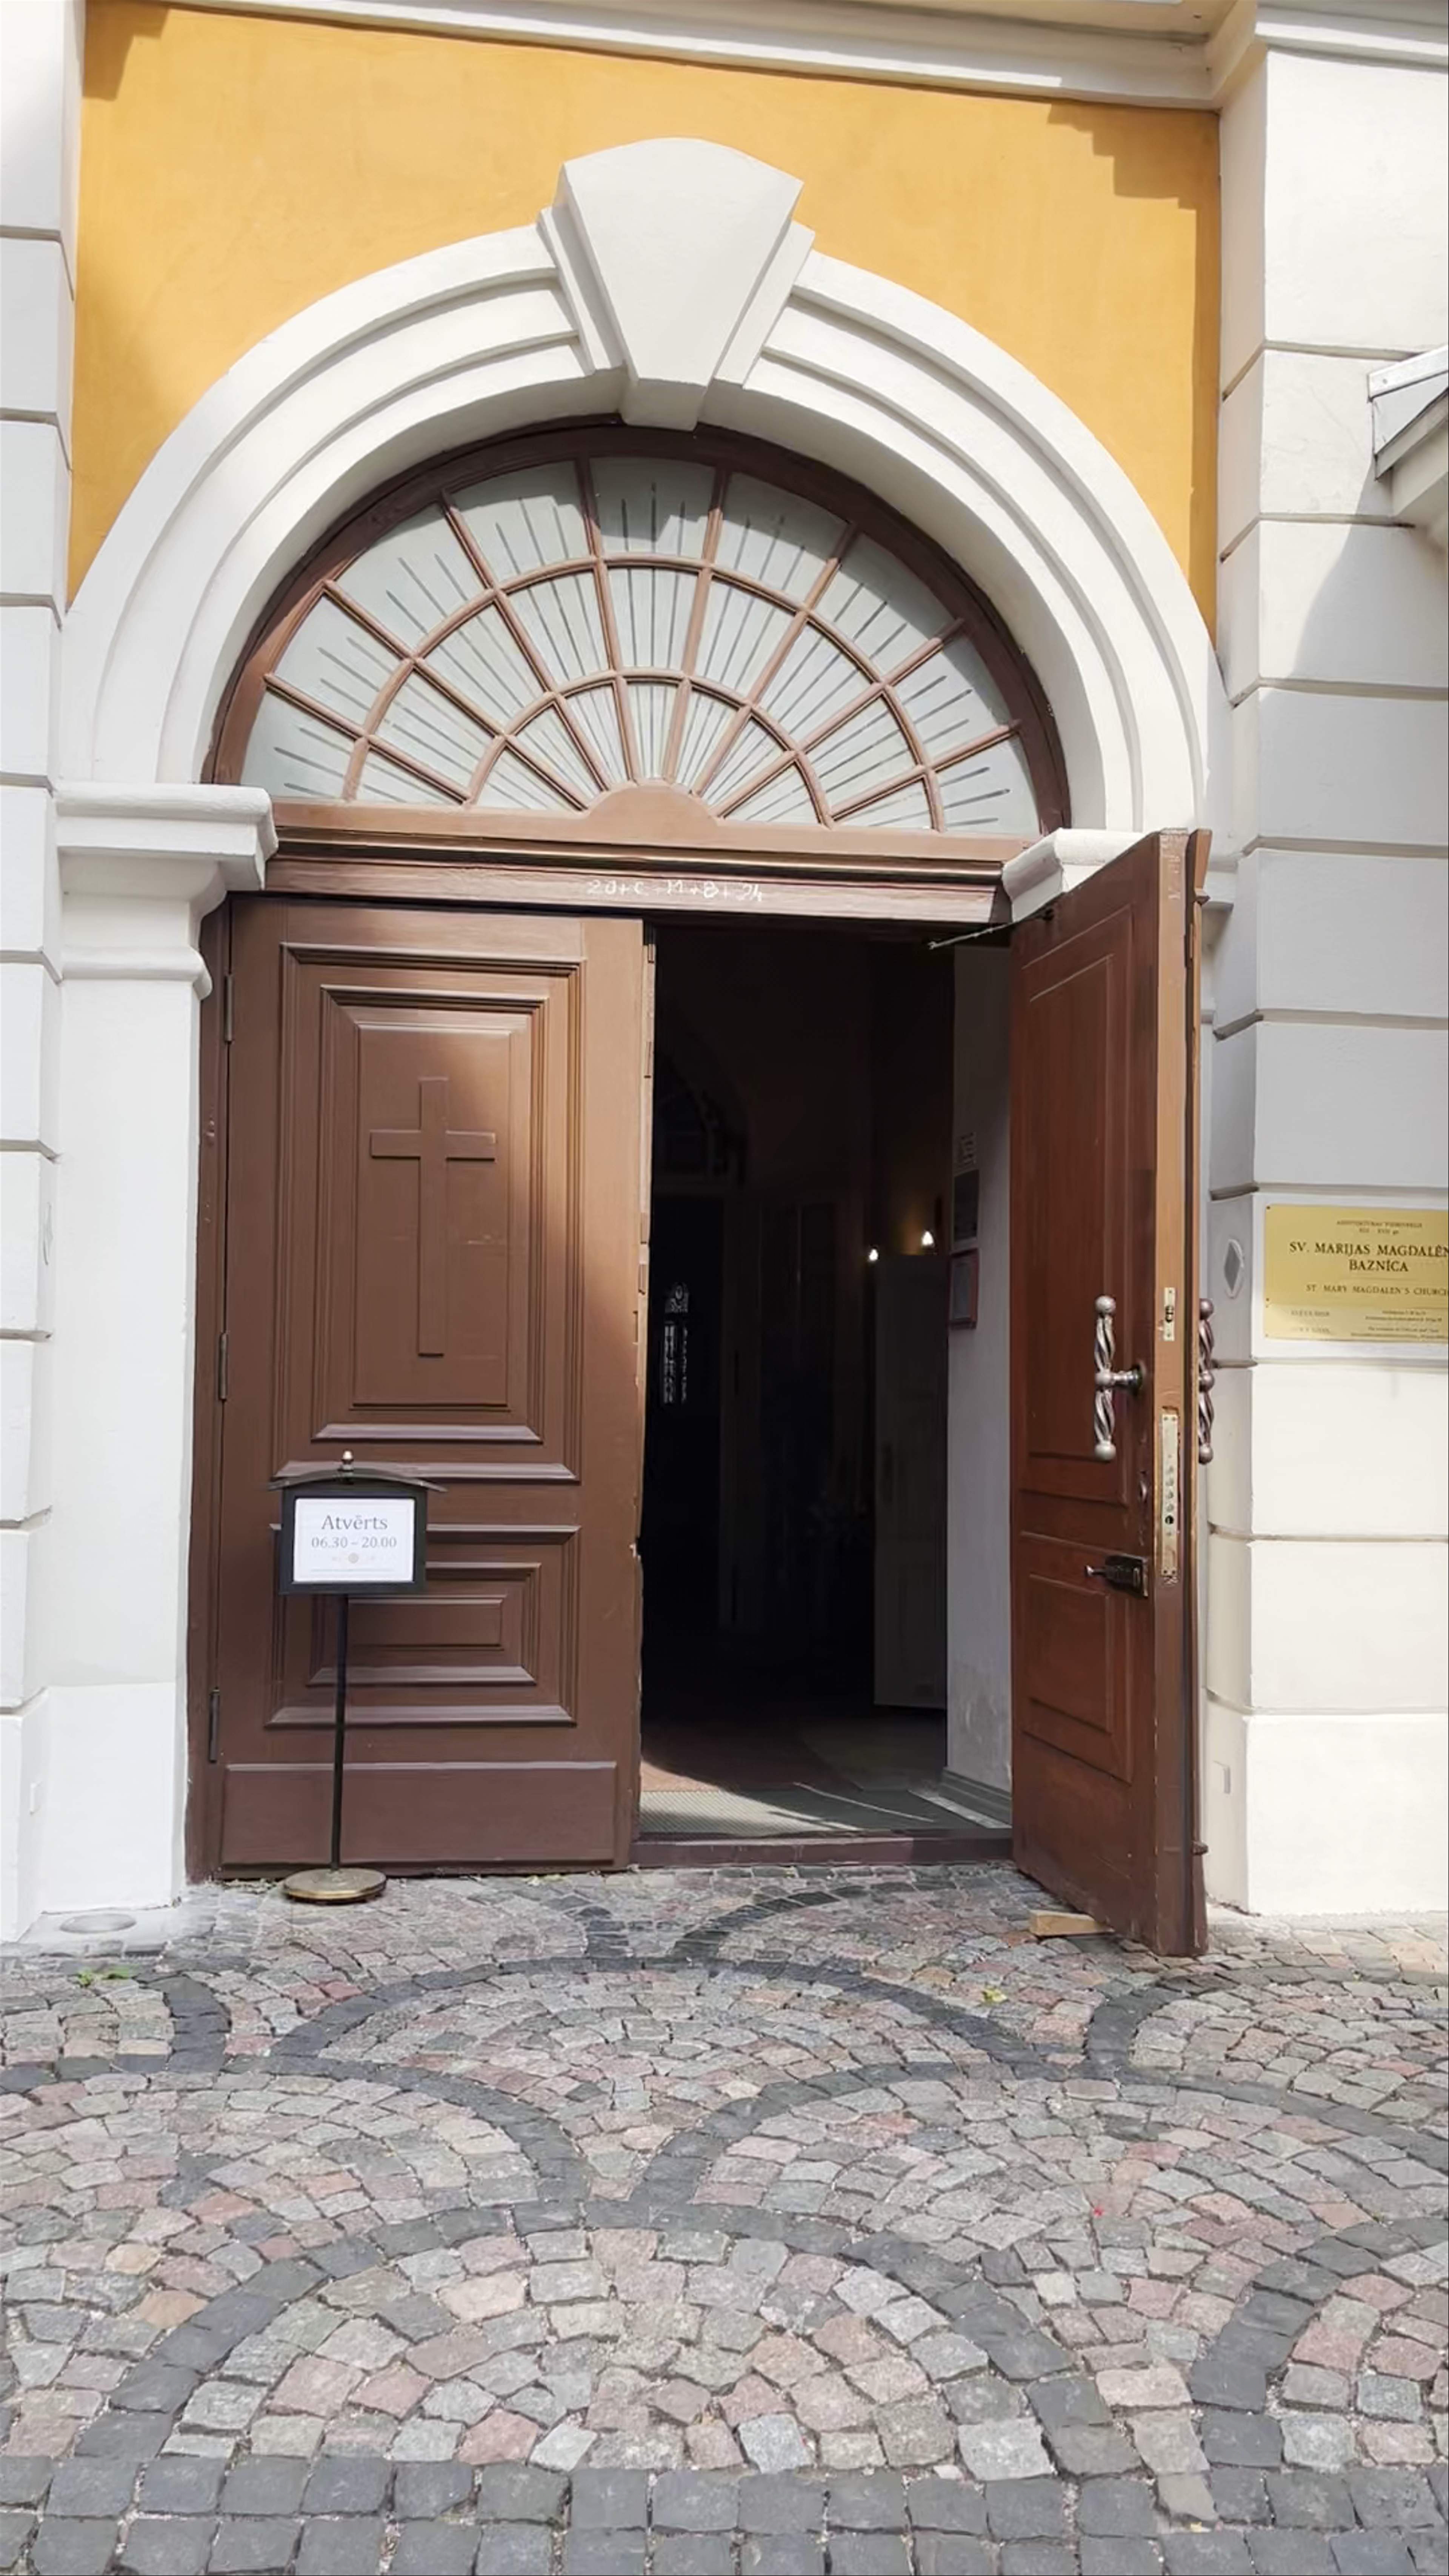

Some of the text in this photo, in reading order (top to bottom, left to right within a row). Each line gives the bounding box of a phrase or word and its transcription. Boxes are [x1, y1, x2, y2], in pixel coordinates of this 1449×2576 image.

[1289, 1241, 1309, 1253] SV.
[1315, 1243, 1370, 1256] MARIJAS
[1349, 1259, 1409, 1272] BAZNĪCA
[1352, 1286, 1410, 1295] MAGDALEN'S
[321, 1515, 388, 1530] Atvērts
[311, 1536, 348, 1549] 06.30
[361, 1536, 397, 1549] 20.00
